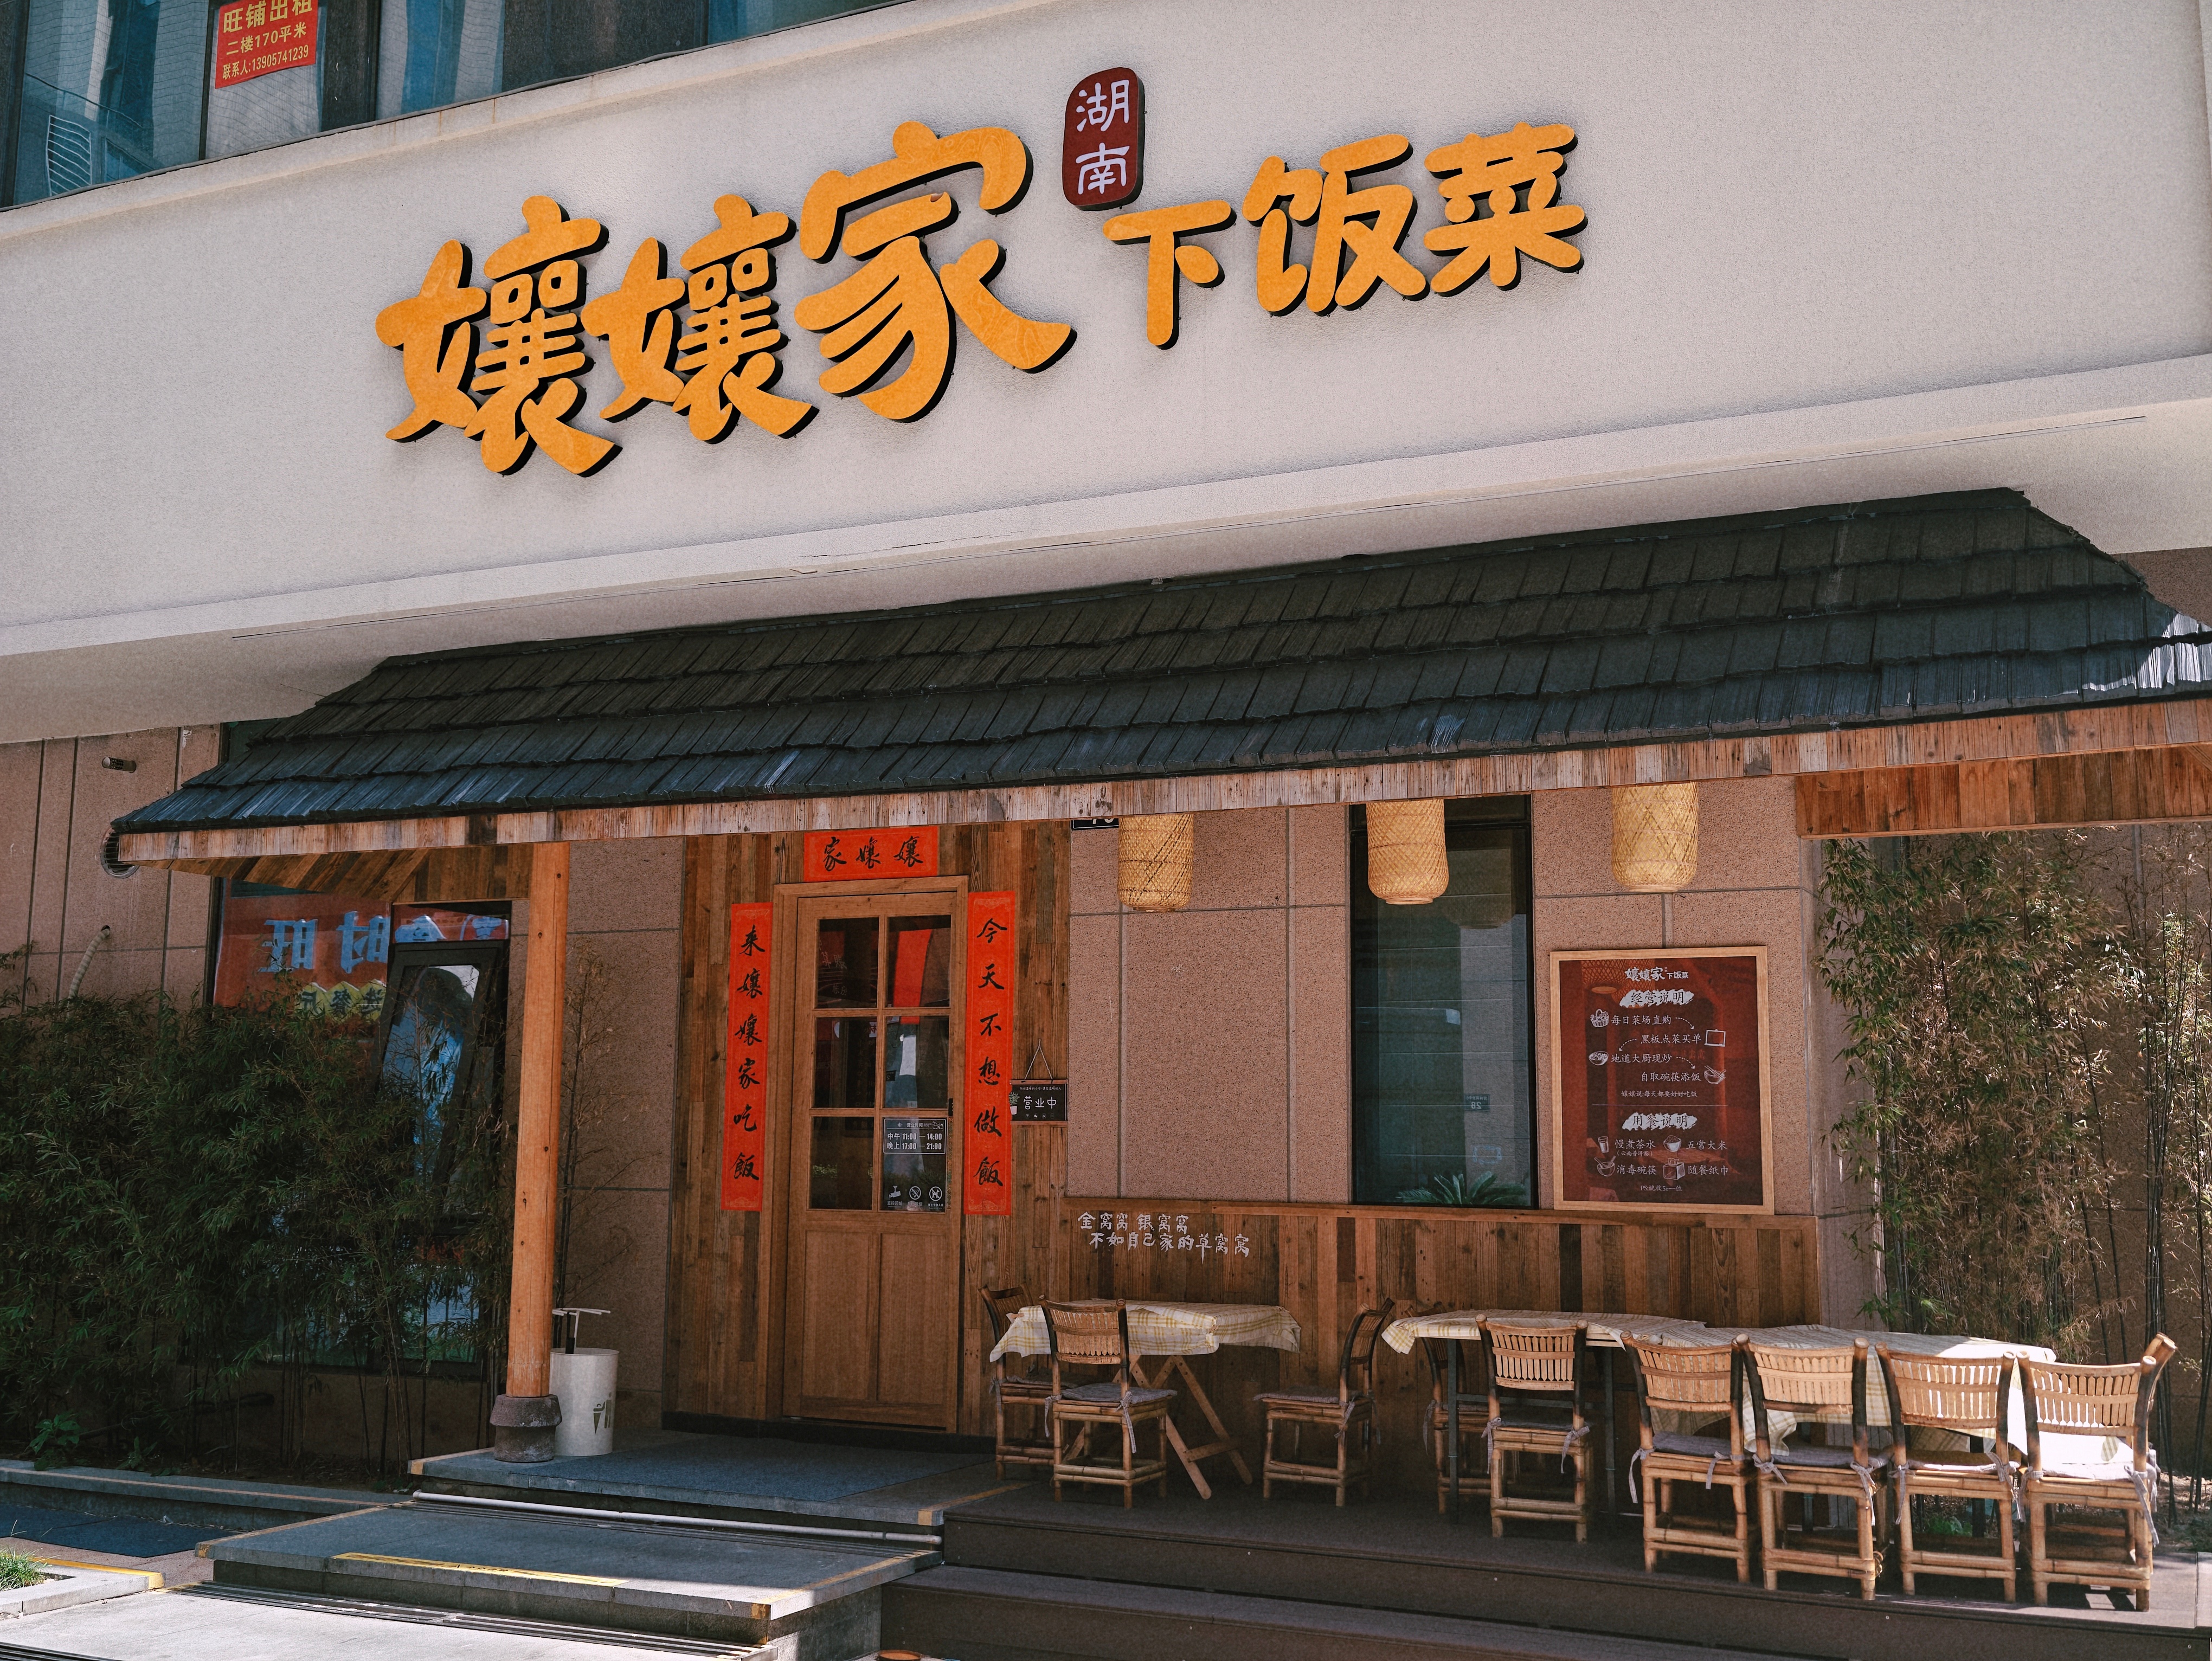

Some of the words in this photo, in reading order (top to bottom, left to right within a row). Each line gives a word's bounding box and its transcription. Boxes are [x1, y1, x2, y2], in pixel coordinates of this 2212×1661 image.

[223, 0, 312, 33] 旺铺出租
[226, 22, 307, 55] 二楼170平米
[222, 44, 309, 80] 联系人:13905741239
[1076, 79, 1130, 195] 湖南
[1103, 122, 1584, 346] 下饭菜
[1667, 971, 1689, 980] 下饭菜
[1630, 992, 1684, 1003] 经营说明
[1611, 1015, 1671, 1026] 每日菜场直购
[1641, 1034, 1702, 1044] 黑板点菜买单
[1611, 1053, 1673, 1064] 地道大厨现炒
[1641, 1071, 1702, 1082] 自取碗筷添饭
[1024, 1096, 1057, 1110] 营业中
[1632, 1115, 1688, 1127] 用餐说明
[1615, 1139, 1656, 1150] 慢煮茶水
[1686, 1140, 1728, 1150] 五常大米
[1617, 1164, 1657, 1175] 消毒碗筷
[1688, 1165, 1729, 1176] 随餐纸巾
